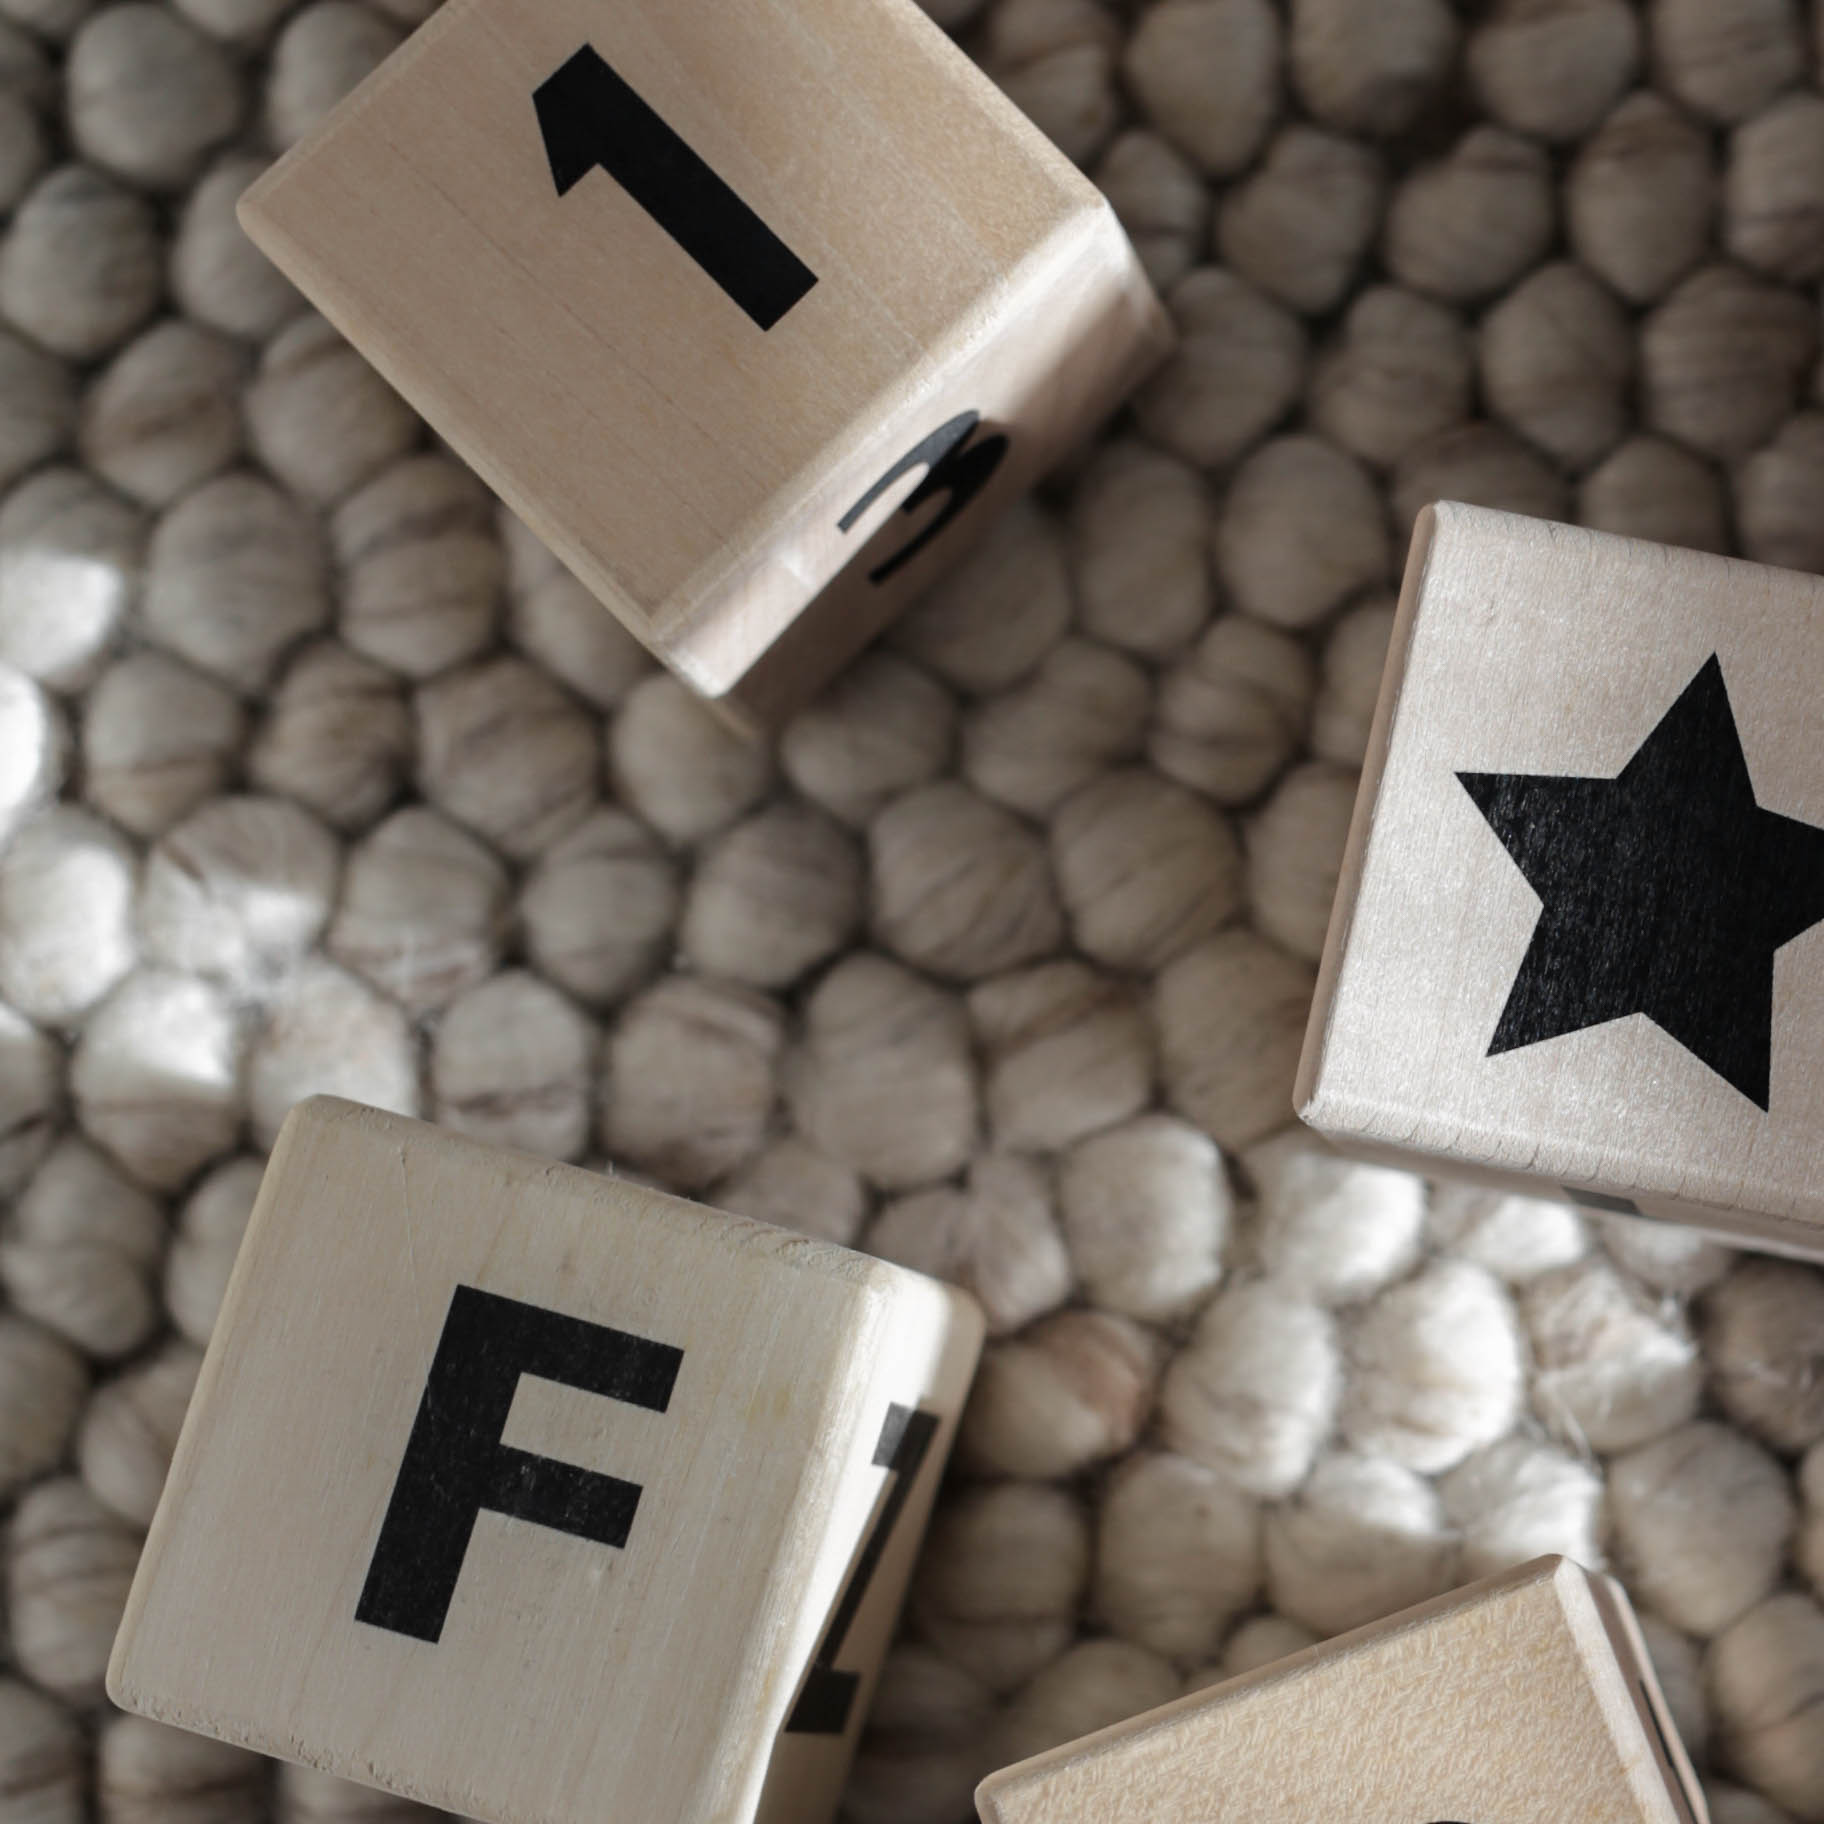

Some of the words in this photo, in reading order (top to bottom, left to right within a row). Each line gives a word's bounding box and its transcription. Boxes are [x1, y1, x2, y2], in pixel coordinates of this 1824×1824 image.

[532, 43, 818, 331] 1
[837, 409, 1008, 587] 3
[355, 1284, 684, 1644] F
